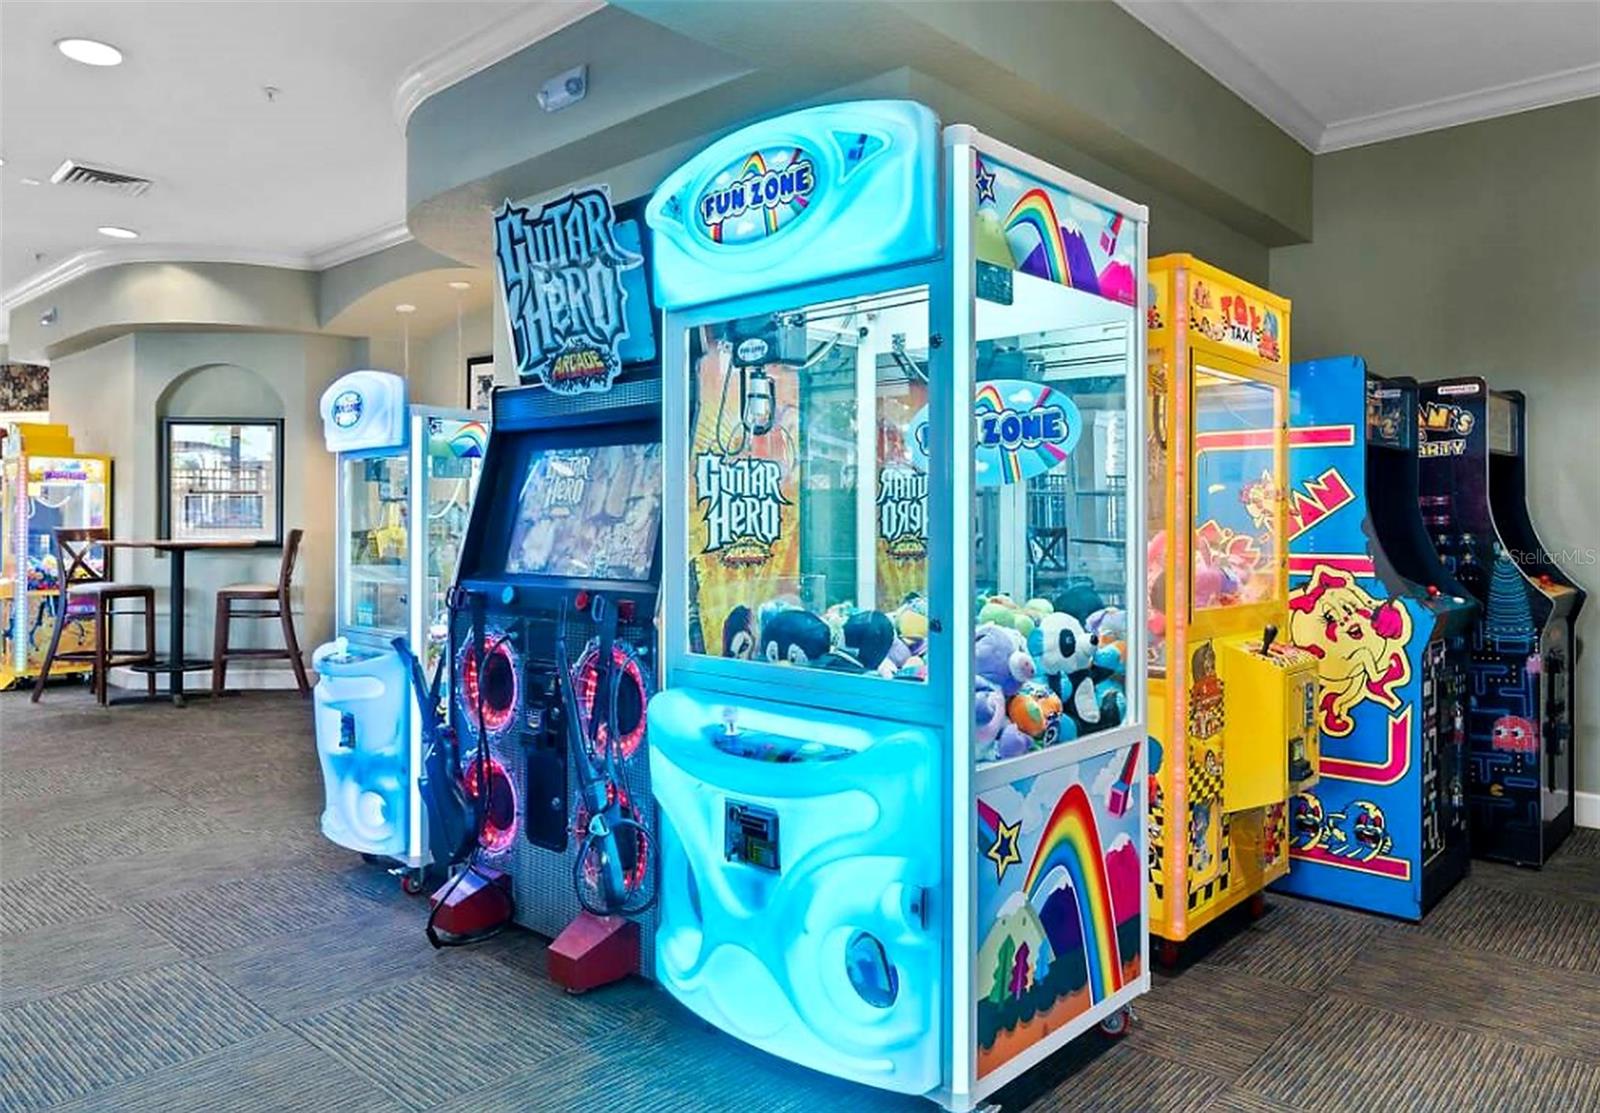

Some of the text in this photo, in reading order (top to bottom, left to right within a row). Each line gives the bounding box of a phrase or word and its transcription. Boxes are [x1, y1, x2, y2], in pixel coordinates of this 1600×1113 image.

[705, 166, 810, 219] FUN ZONE
[1220, 295, 1261, 331] TOY
[1229, 325, 1254, 343] TAXI
[552, 350, 606, 379] ARCADE
[983, 411, 1062, 443] ZONE
